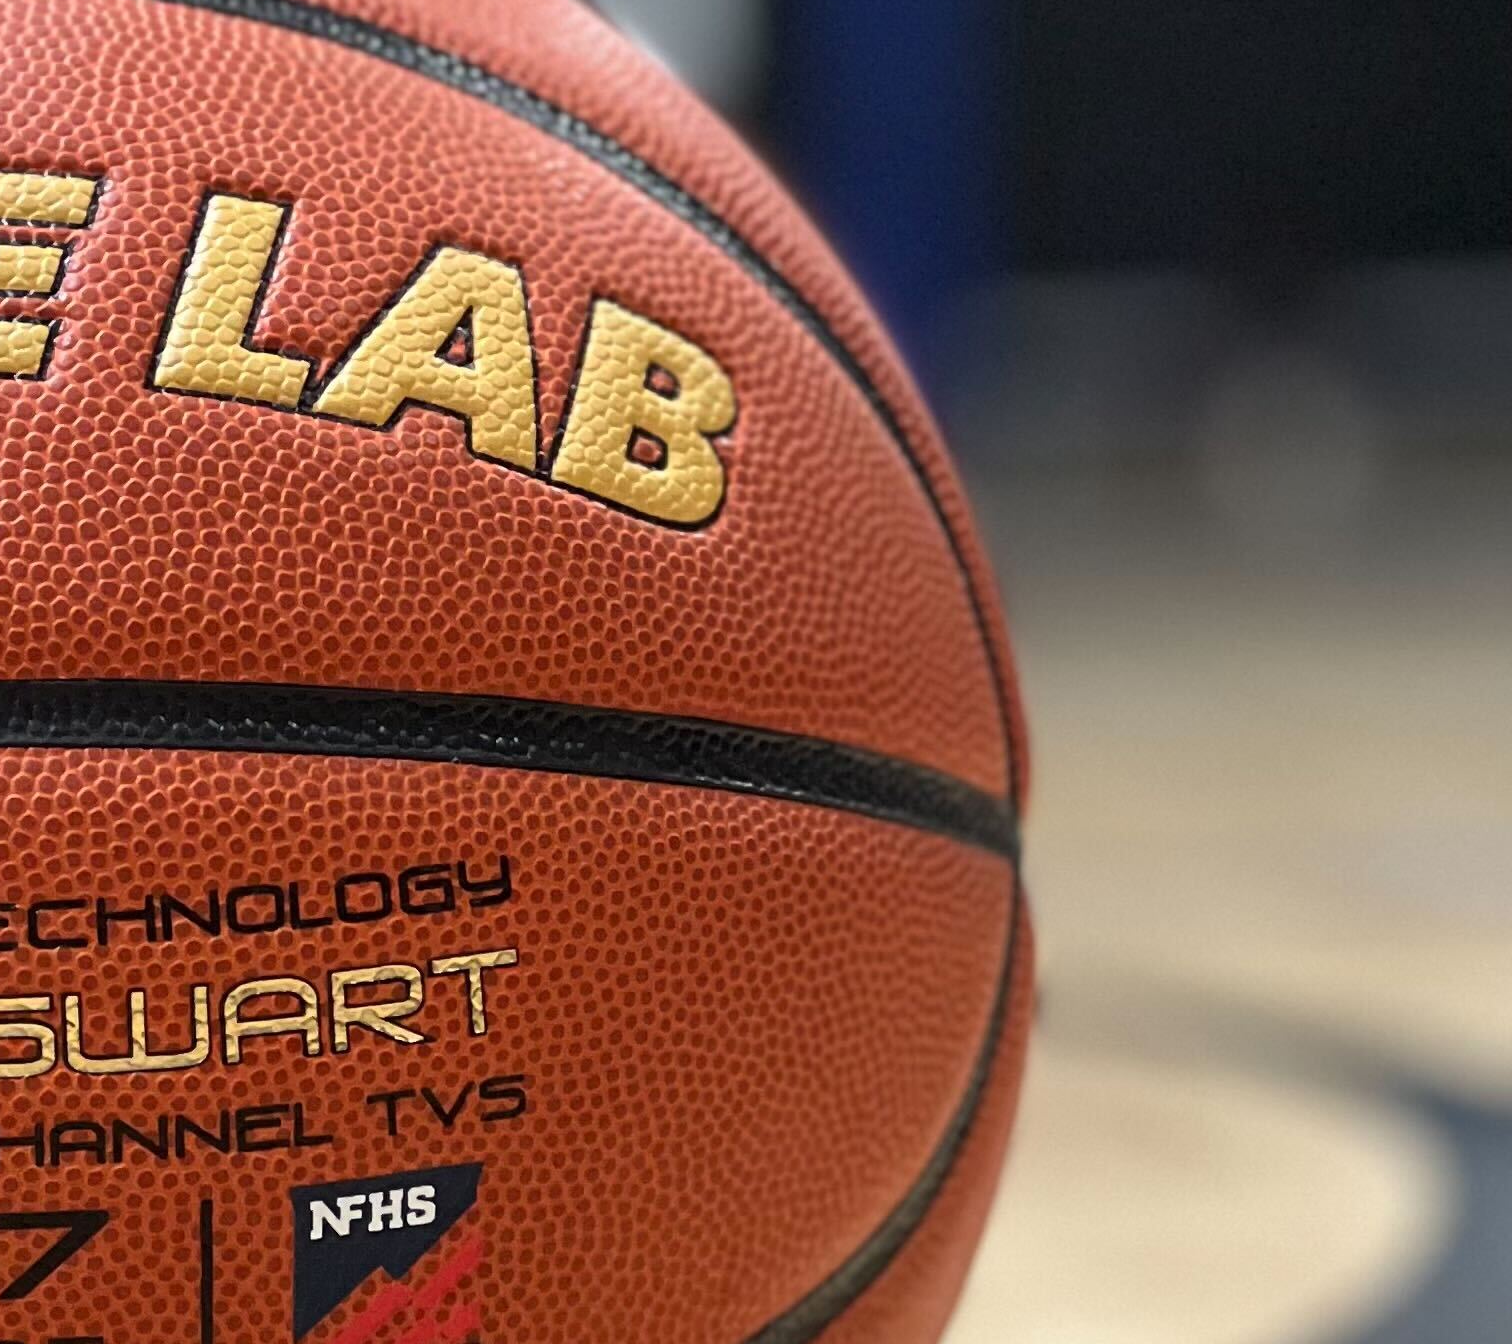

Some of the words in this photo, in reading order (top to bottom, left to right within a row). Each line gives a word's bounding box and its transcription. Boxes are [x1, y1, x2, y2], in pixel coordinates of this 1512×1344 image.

[146, 192, 740, 532] LAB
[367, 1074, 528, 1137] TVS
[309, 1184, 437, 1241] NFHS
